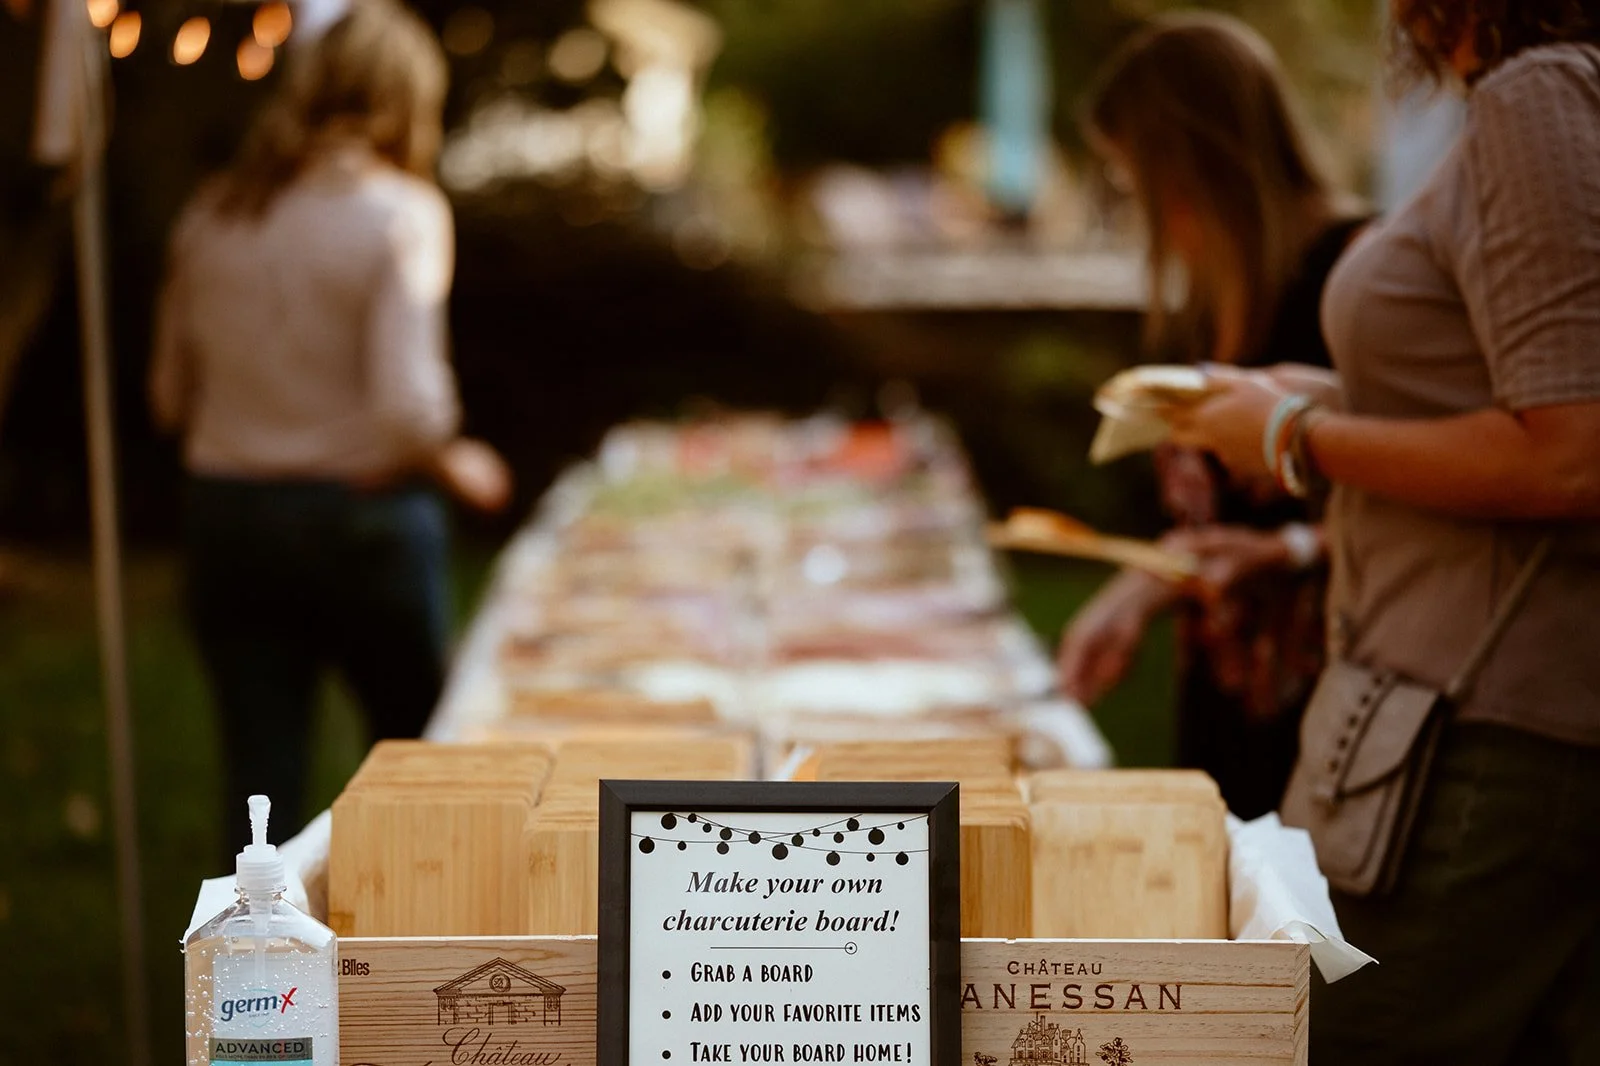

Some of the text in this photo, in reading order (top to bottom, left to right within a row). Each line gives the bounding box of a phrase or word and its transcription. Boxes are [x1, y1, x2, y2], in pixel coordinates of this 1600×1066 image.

[686, 871, 884, 900] Make your own
[662, 909, 901, 932] charcuterie board!
[690, 961, 813, 983] GRAB A BOARD
[1007, 958, 1103, 976] CHÂTEAU
[961, 983, 1184, 1010] ANESSAN
[690, 1002, 921, 1023] ADD YOUR FAVORITE ITEMS
[215, 1042, 305, 1054] ADVANCED
[690, 1041, 912, 1064] TAKE YOUR BOARD HOME!
